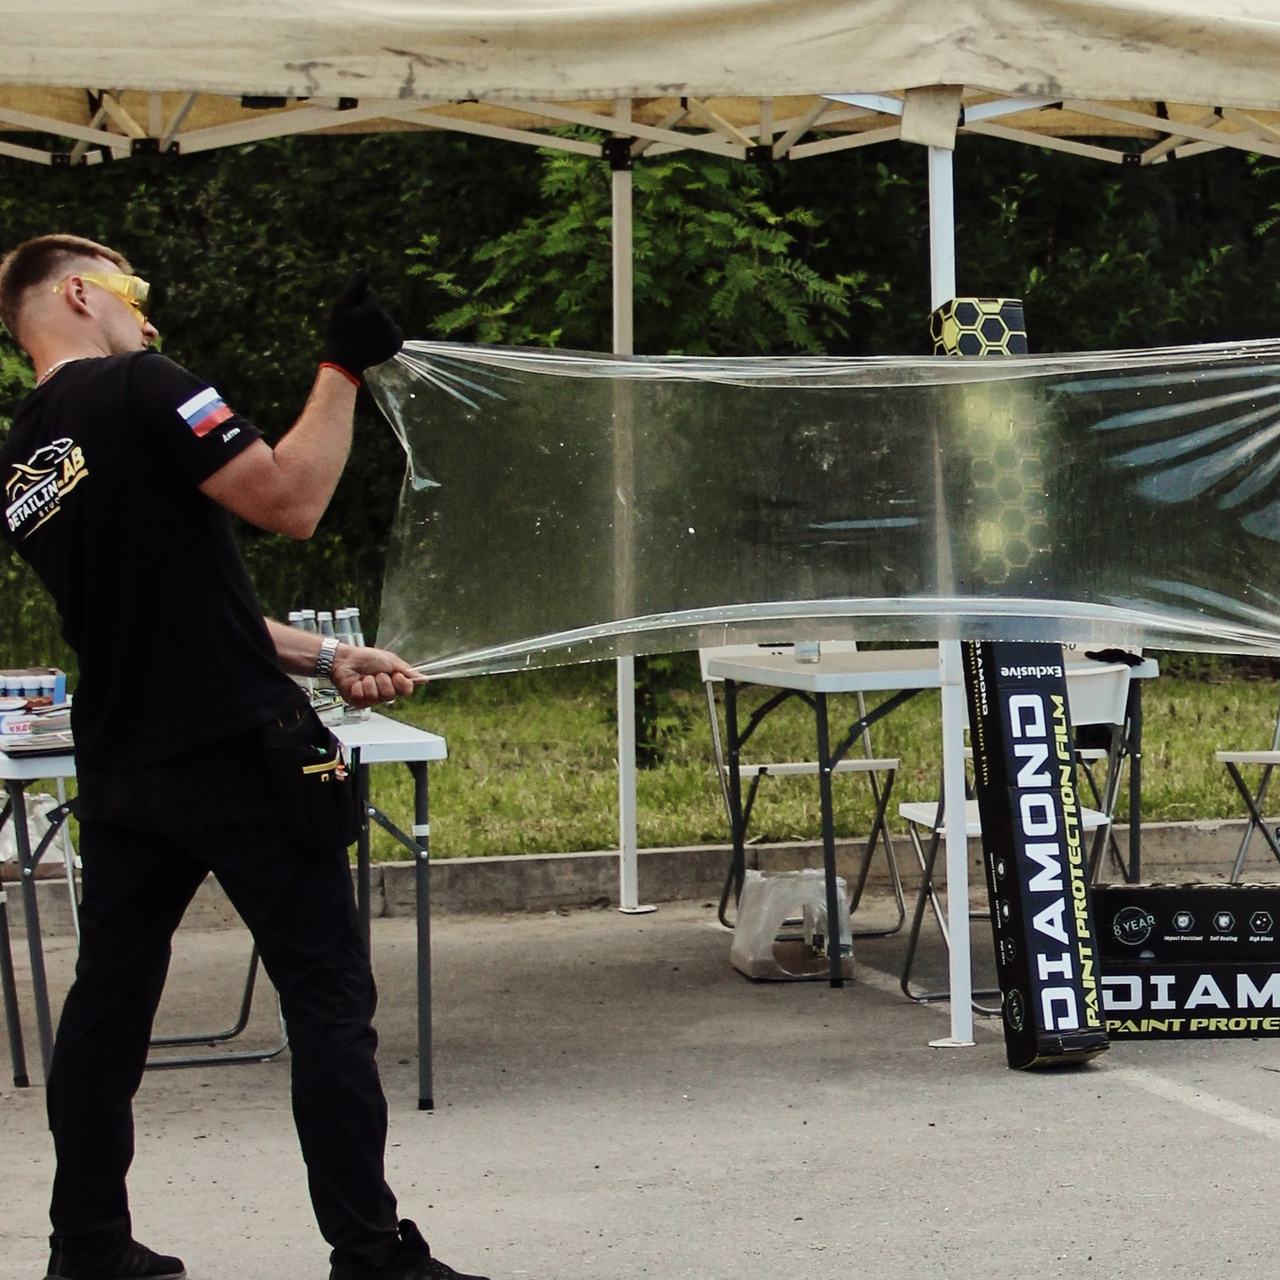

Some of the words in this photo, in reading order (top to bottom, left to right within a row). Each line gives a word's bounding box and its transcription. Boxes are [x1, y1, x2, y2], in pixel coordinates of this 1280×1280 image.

[7, 480, 59, 532] DETAILIN
[1001, 665, 1063, 678] Exclusive
[1050, 694, 1070, 761] FILM
[1009, 694, 1080, 1031] DIAMOND
[1059, 765, 1090, 939] PROTECTION
[1113, 924, 1122, 937] 8
[1123, 915, 1156, 932] YEAR
[1078, 942, 1101, 1027] PAINT
[1106, 1019, 1186, 1032] PAINT
